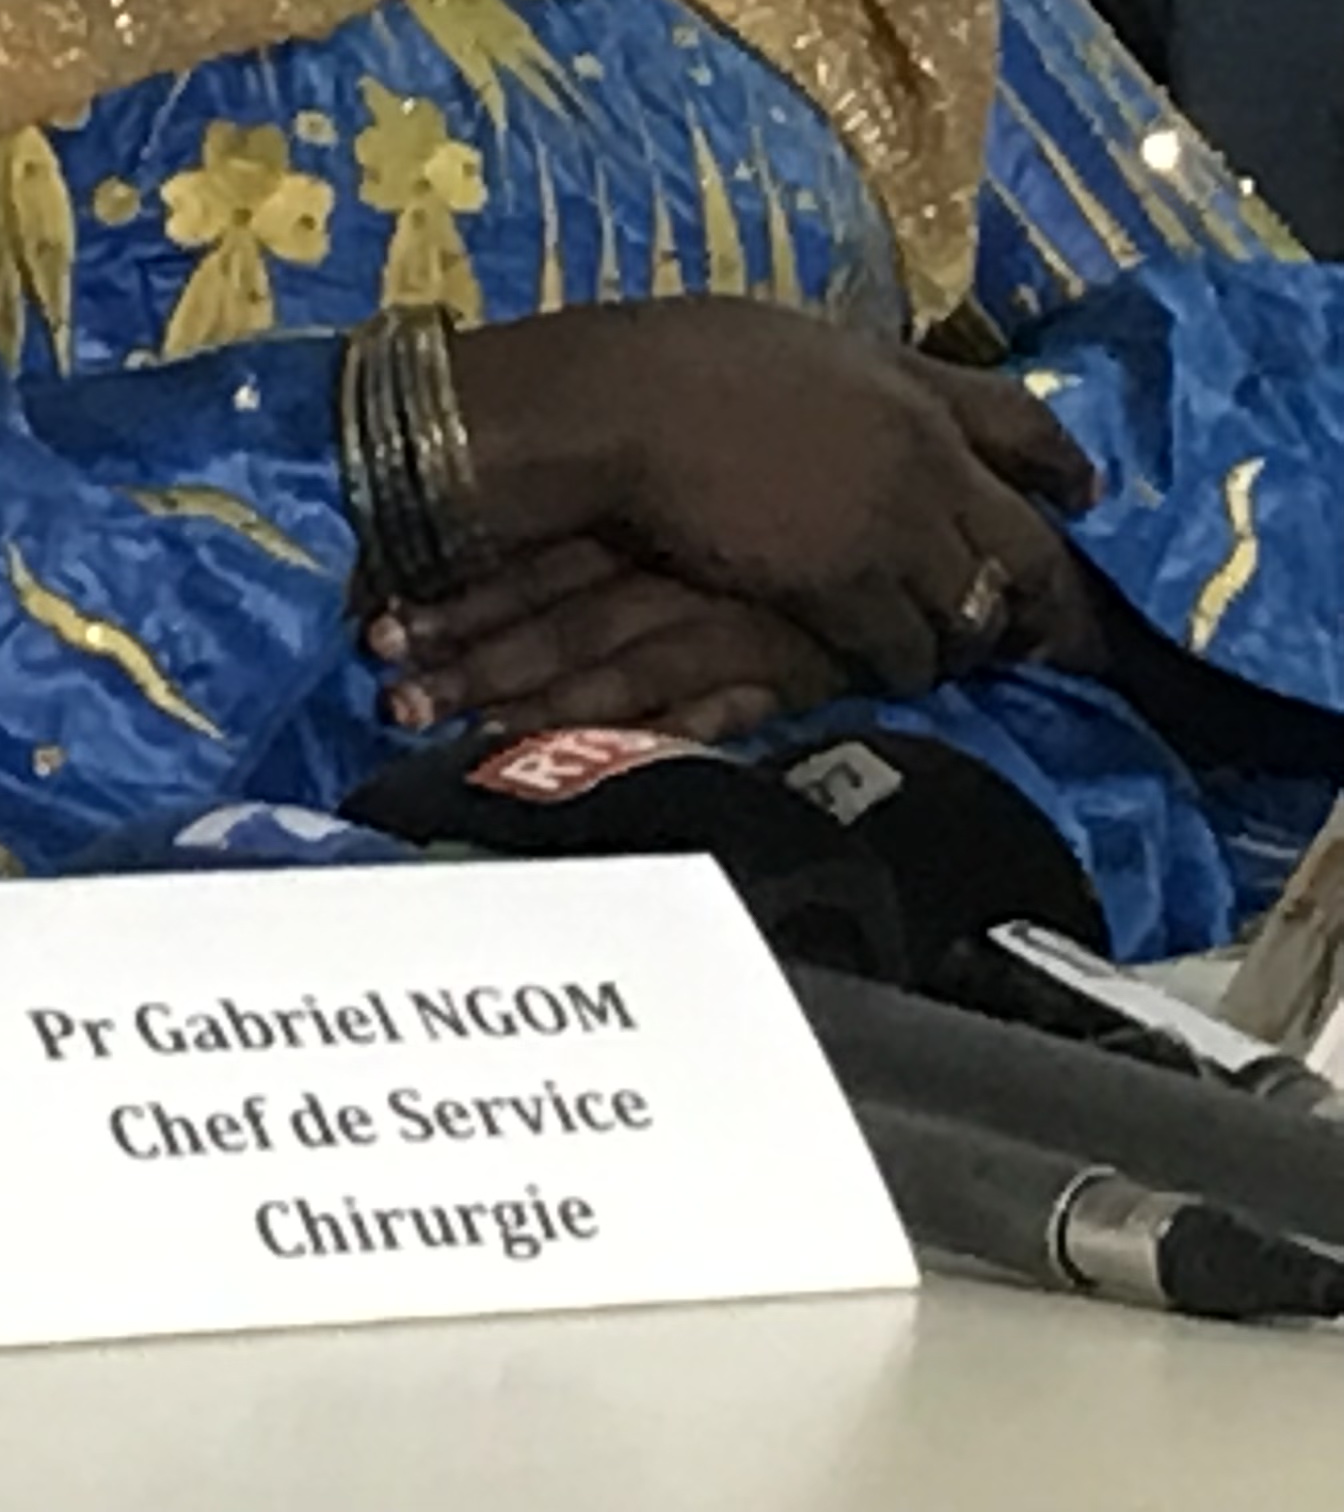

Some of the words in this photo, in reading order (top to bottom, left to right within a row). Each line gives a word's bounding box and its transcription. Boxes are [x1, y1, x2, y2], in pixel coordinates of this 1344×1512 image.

[28, 1008, 113, 1061] Pr
[134, 990, 402, 1055] Gabriel
[408, 981, 638, 1040] NGOM
[108, 1095, 274, 1160] Chef
[288, 1091, 378, 1149] de
[386, 1080, 653, 1142] Service
[254, 1183, 600, 1261] Chirurgie
